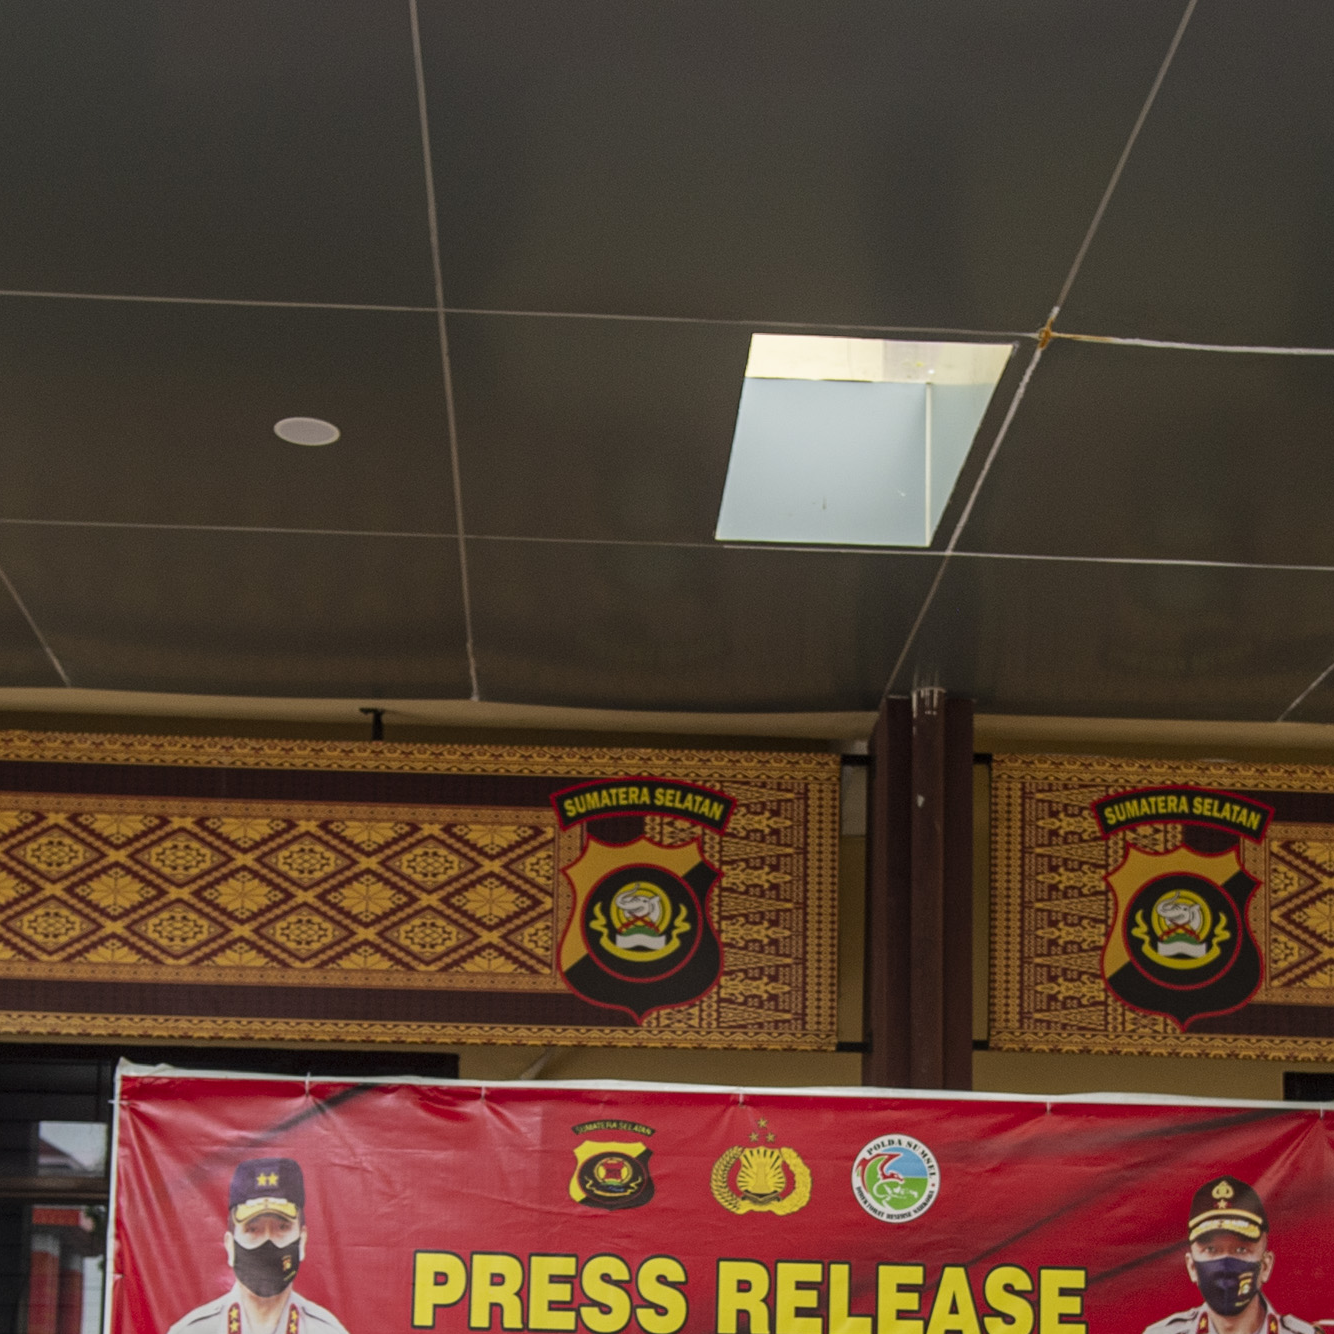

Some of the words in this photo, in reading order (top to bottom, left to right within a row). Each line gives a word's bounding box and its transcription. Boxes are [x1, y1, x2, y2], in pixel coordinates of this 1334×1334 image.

[563, 786, 652, 817] SUMATERA
[654, 787, 726, 820] SELATAN
[1103, 795, 1189, 826] SUMATERA
[1191, 796, 1261, 830] SELATAN
[619, 1120, 654, 1136] SELATAN
[867, 1139, 903, 1155] POLDA
[907, 1140, 936, 1178] SUMSEL
